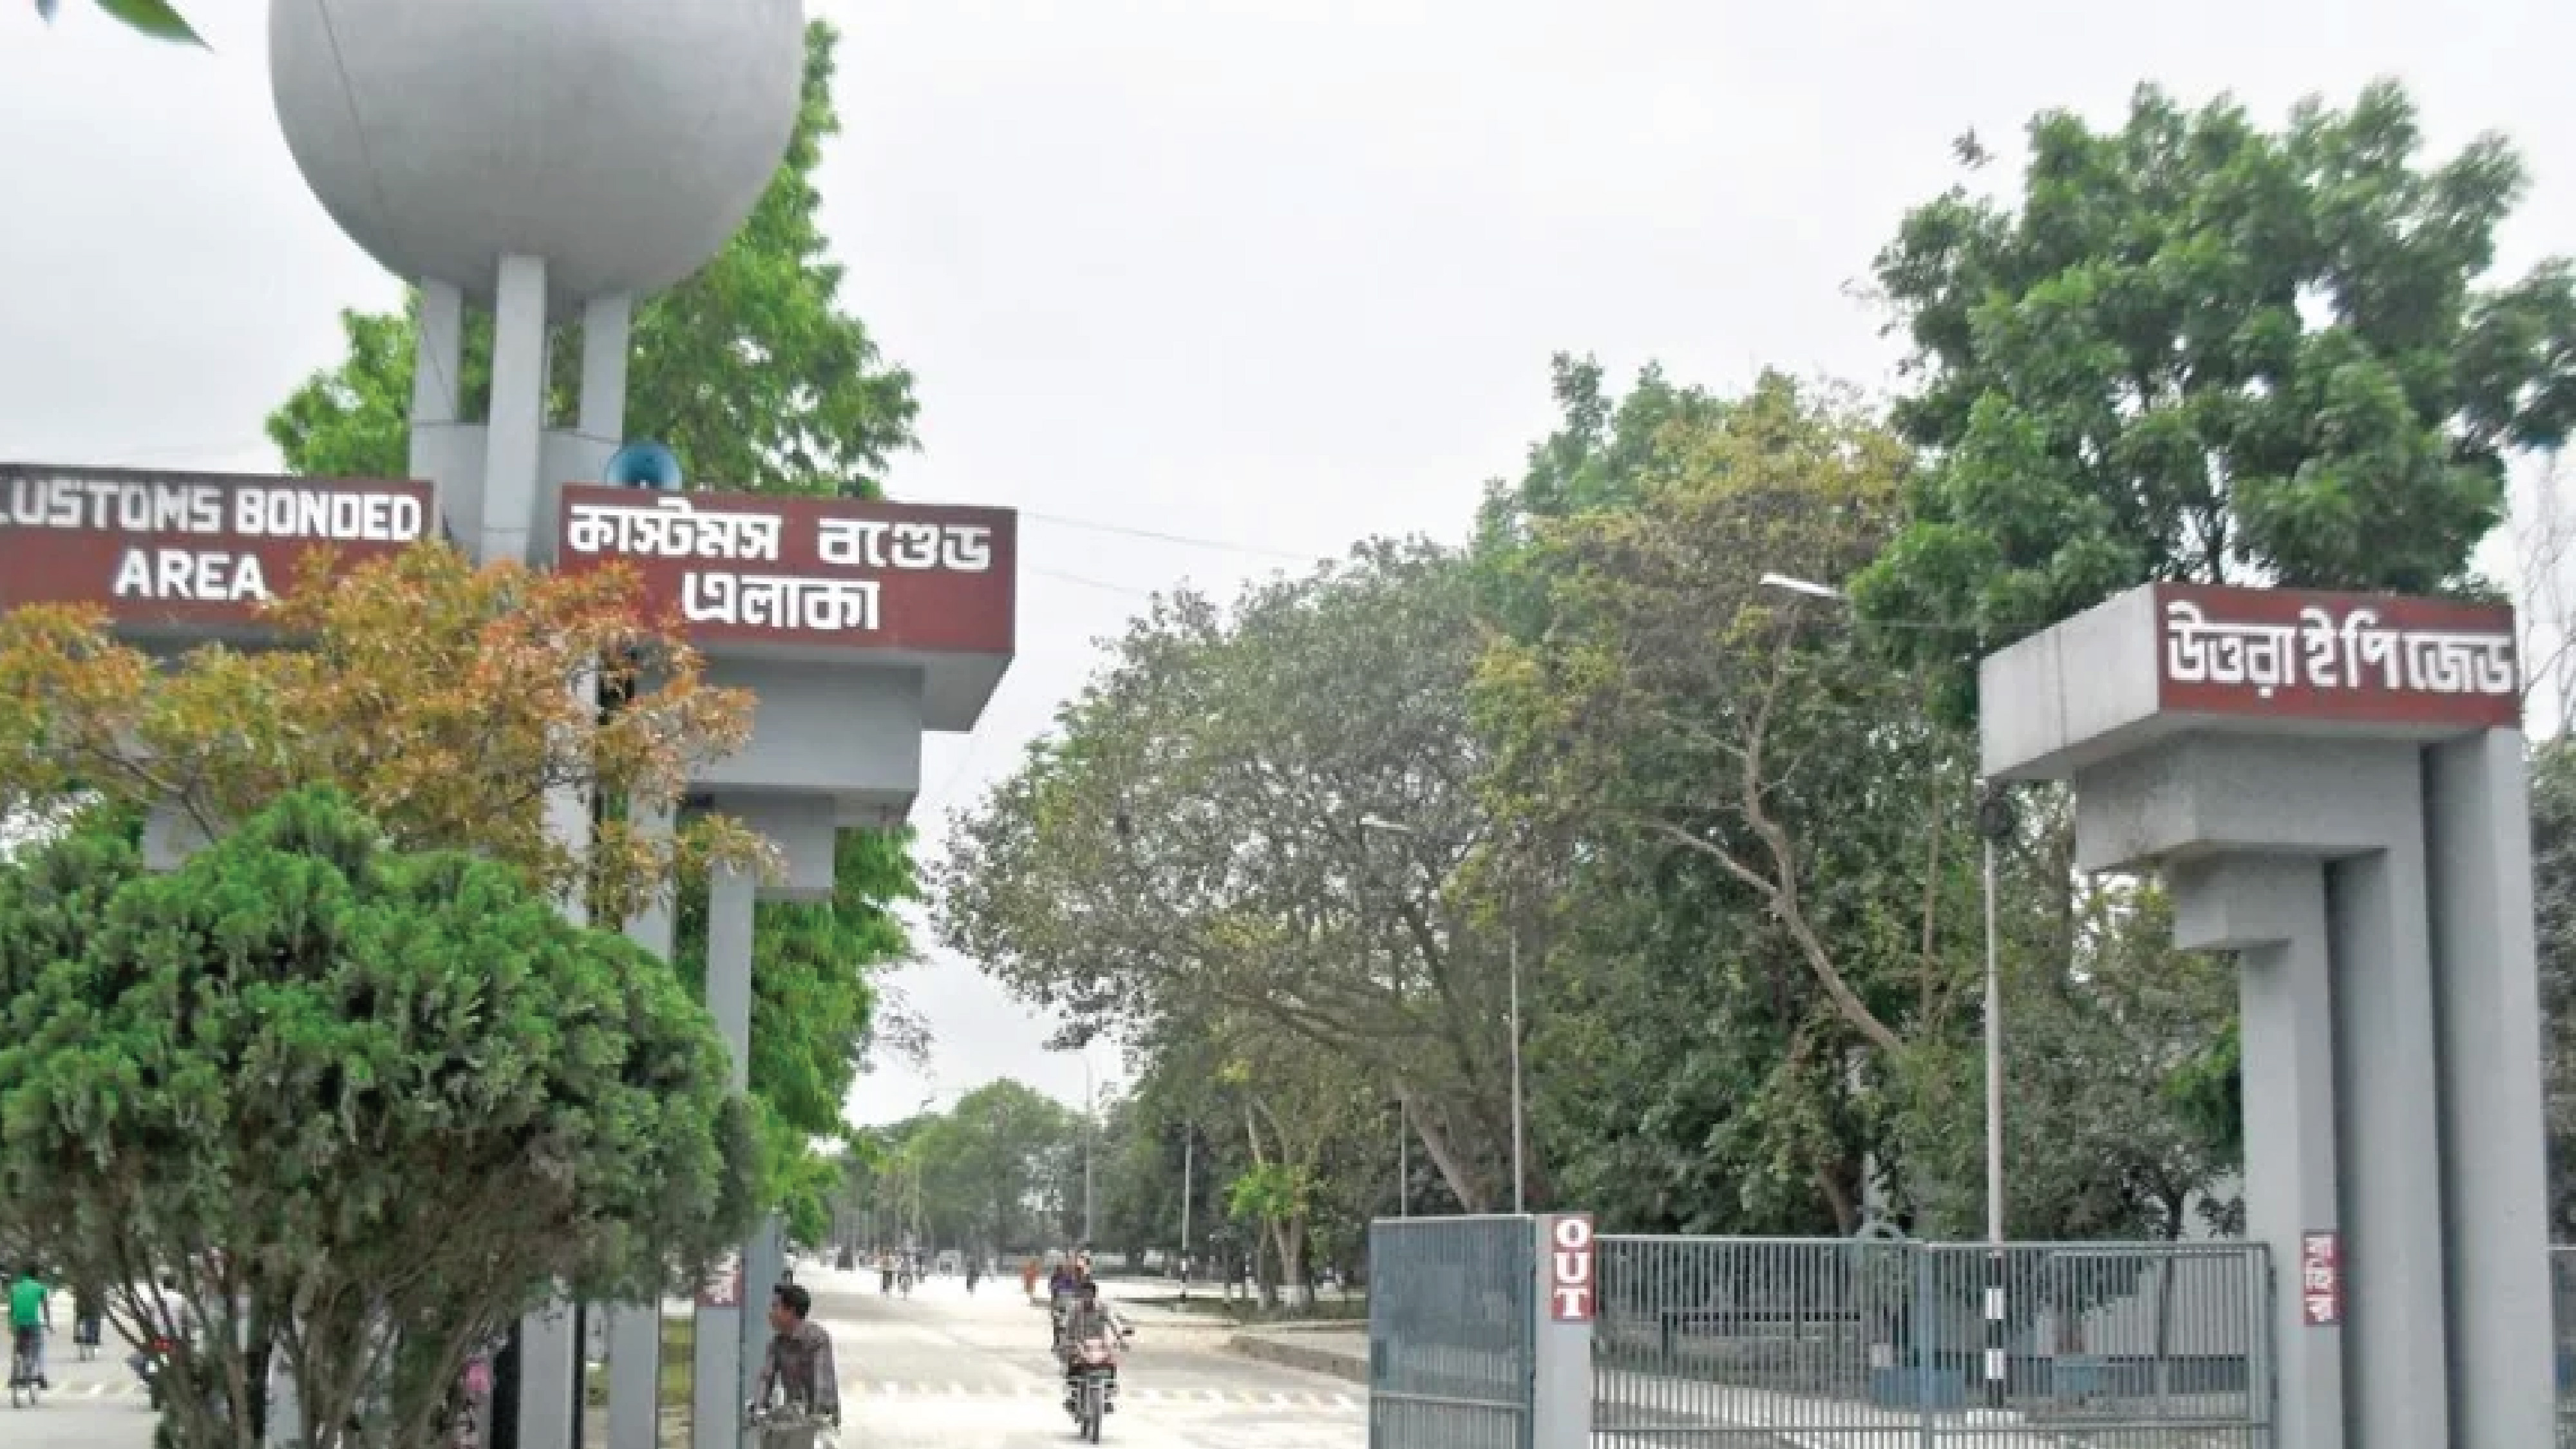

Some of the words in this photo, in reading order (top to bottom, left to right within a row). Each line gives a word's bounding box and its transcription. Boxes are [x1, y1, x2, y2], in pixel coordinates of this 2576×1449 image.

[0, 478, 223, 533] USTOMS
[234, 489, 422, 542] BONDED
[567, 497, 783, 562] কাস্টমস
[113, 547, 267, 601] AREA
[680, 572, 880, 630] এলাকা
[1553, 1218, 1591, 1319] OUT
